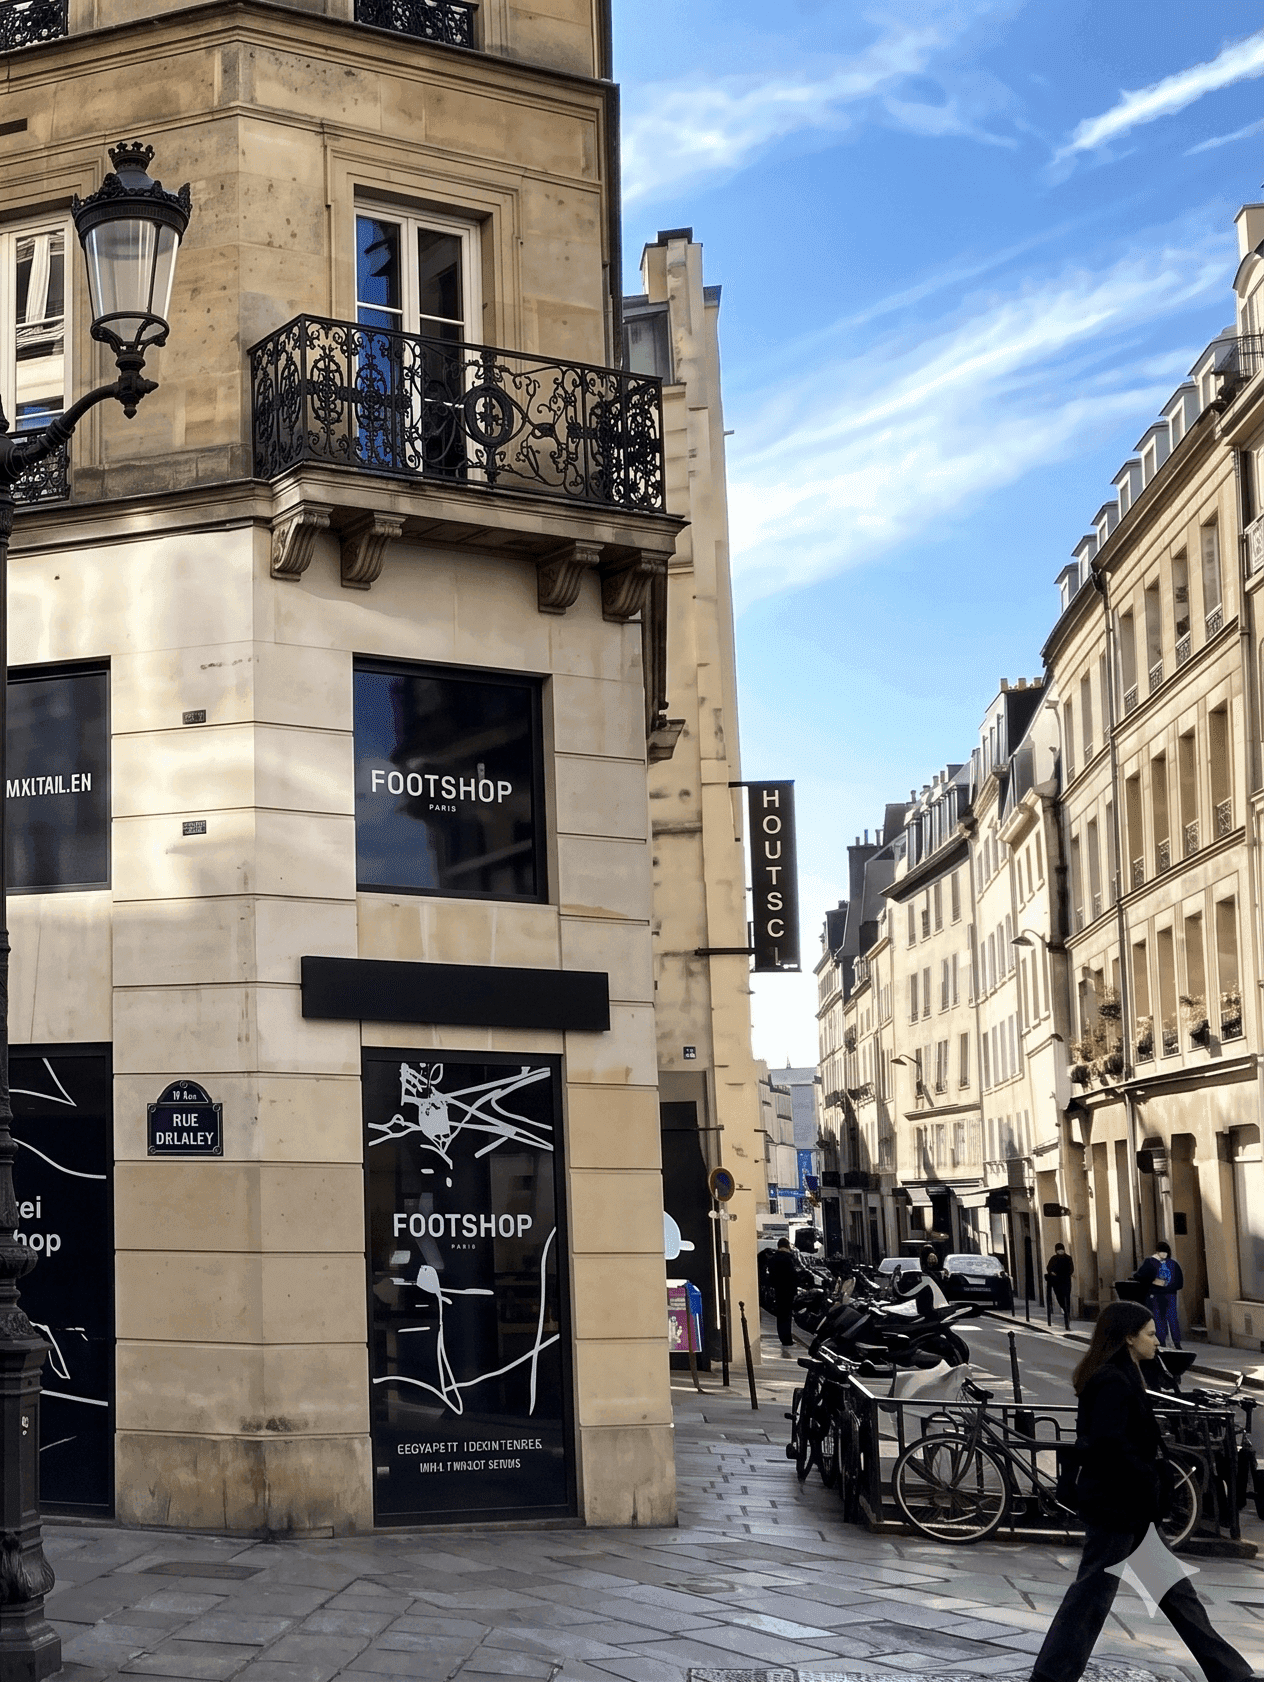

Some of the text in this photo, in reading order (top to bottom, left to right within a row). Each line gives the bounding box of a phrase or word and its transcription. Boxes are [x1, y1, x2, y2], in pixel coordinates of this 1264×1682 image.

[371, 769, 513, 803] FOOTSHOP
[429, 804, 457, 812] PARIS
[173, 1113, 199, 1127] RUE
[156, 1132, 214, 1145] DRLALEY
[393, 1213, 533, 1238] FOOTSHOP
